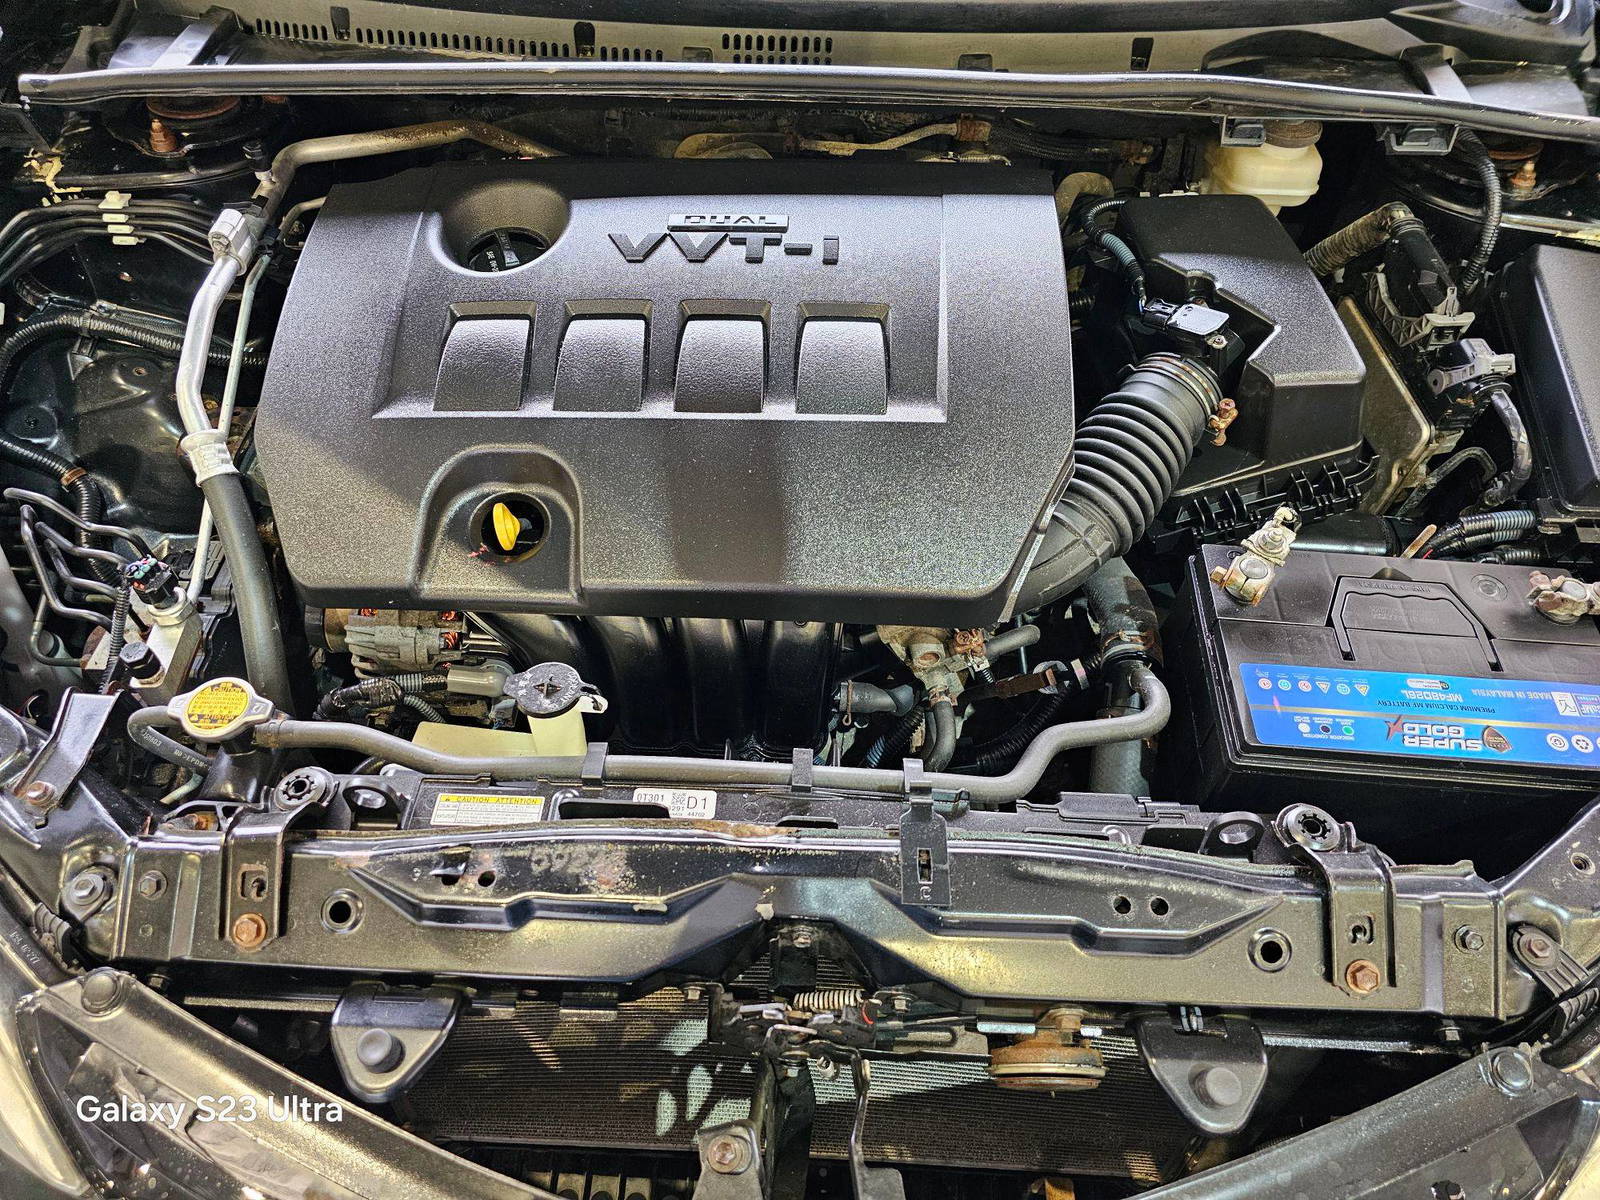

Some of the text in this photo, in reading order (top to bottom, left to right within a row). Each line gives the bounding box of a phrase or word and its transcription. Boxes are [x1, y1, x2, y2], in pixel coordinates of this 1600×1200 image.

[683, 214, 778, 225] DUAL
[1471, 688, 1552, 700] MADE IN MALAYSIA
[1377, 699, 1496, 714] PREMIUM CALCIUM MF BATTERY
[1402, 722, 1466, 738] GOLD
[1403, 734, 1483, 752] SUPER
[495, 797, 539, 805] ATTENTION
[686, 795, 707, 810] D1
